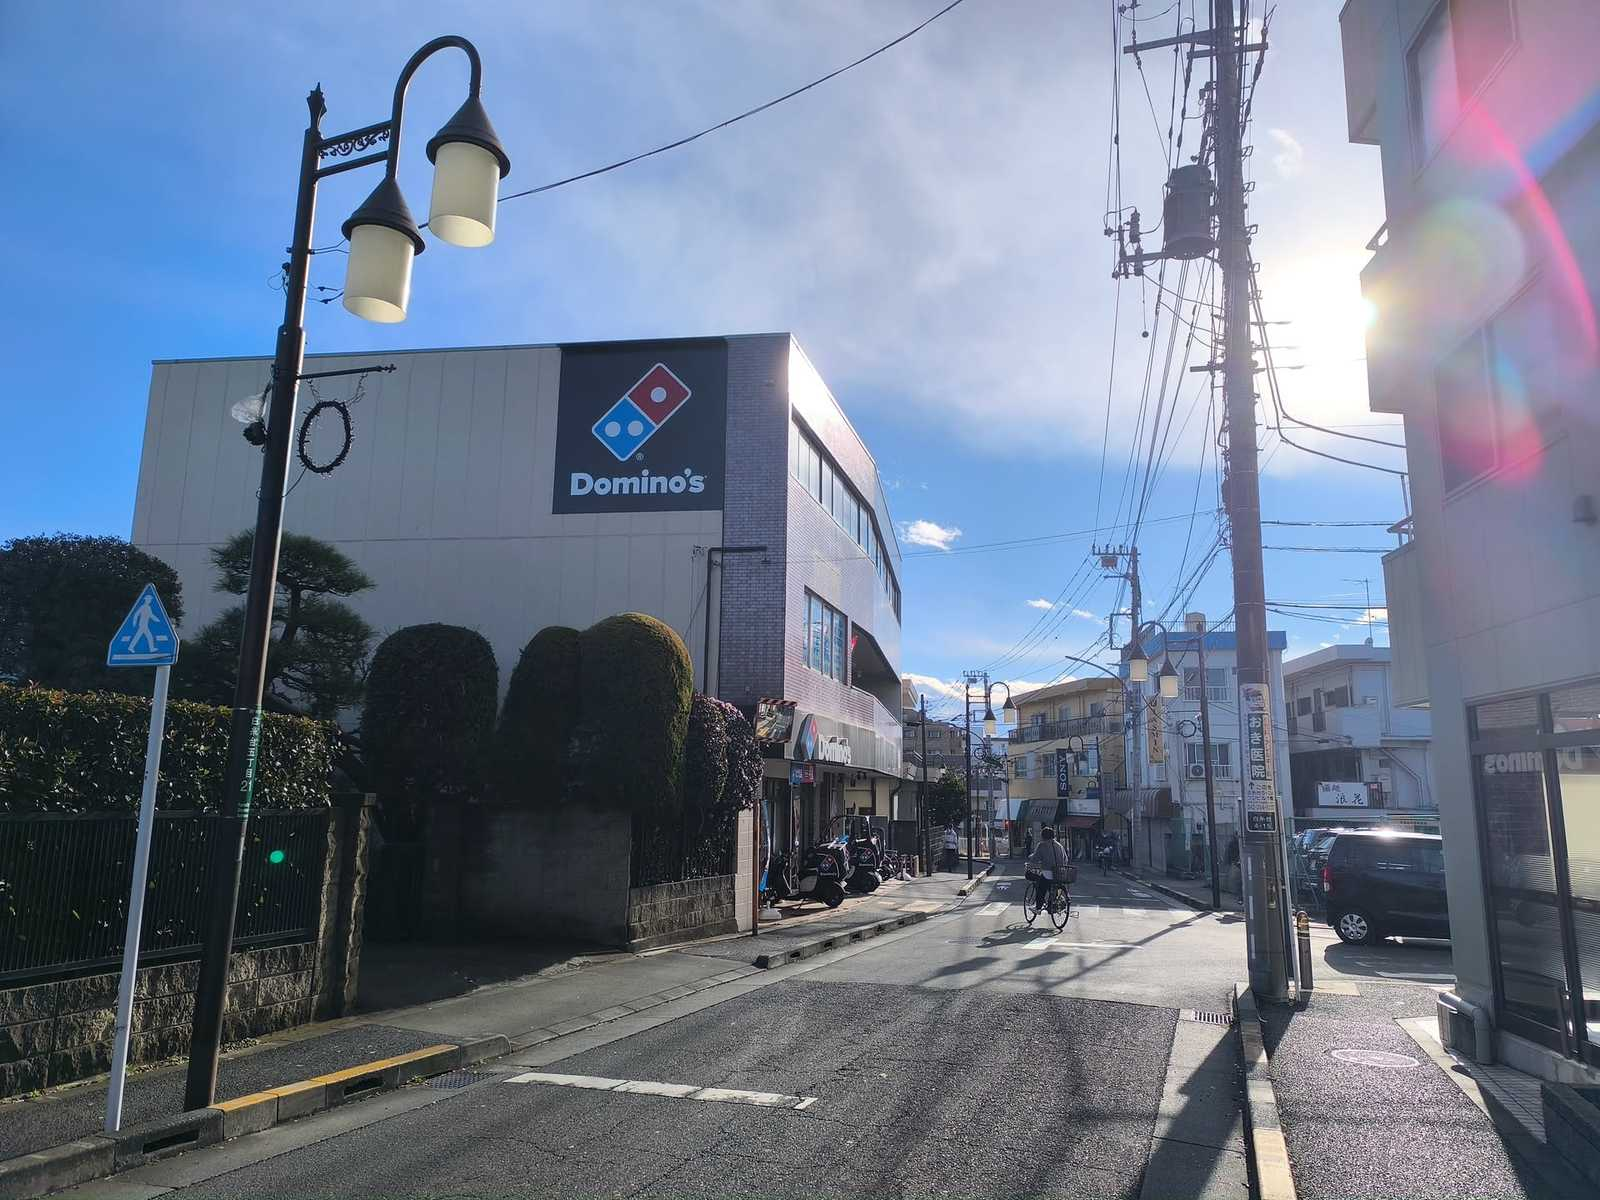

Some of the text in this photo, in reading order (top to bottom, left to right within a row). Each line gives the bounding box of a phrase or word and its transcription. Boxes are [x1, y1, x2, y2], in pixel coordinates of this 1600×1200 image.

[570, 467, 705, 496] Domino's
[1059, 755, 1068, 791] SONY
[239, 779, 252, 792] 21
[1335, 792, 1364, 805] 浪花
